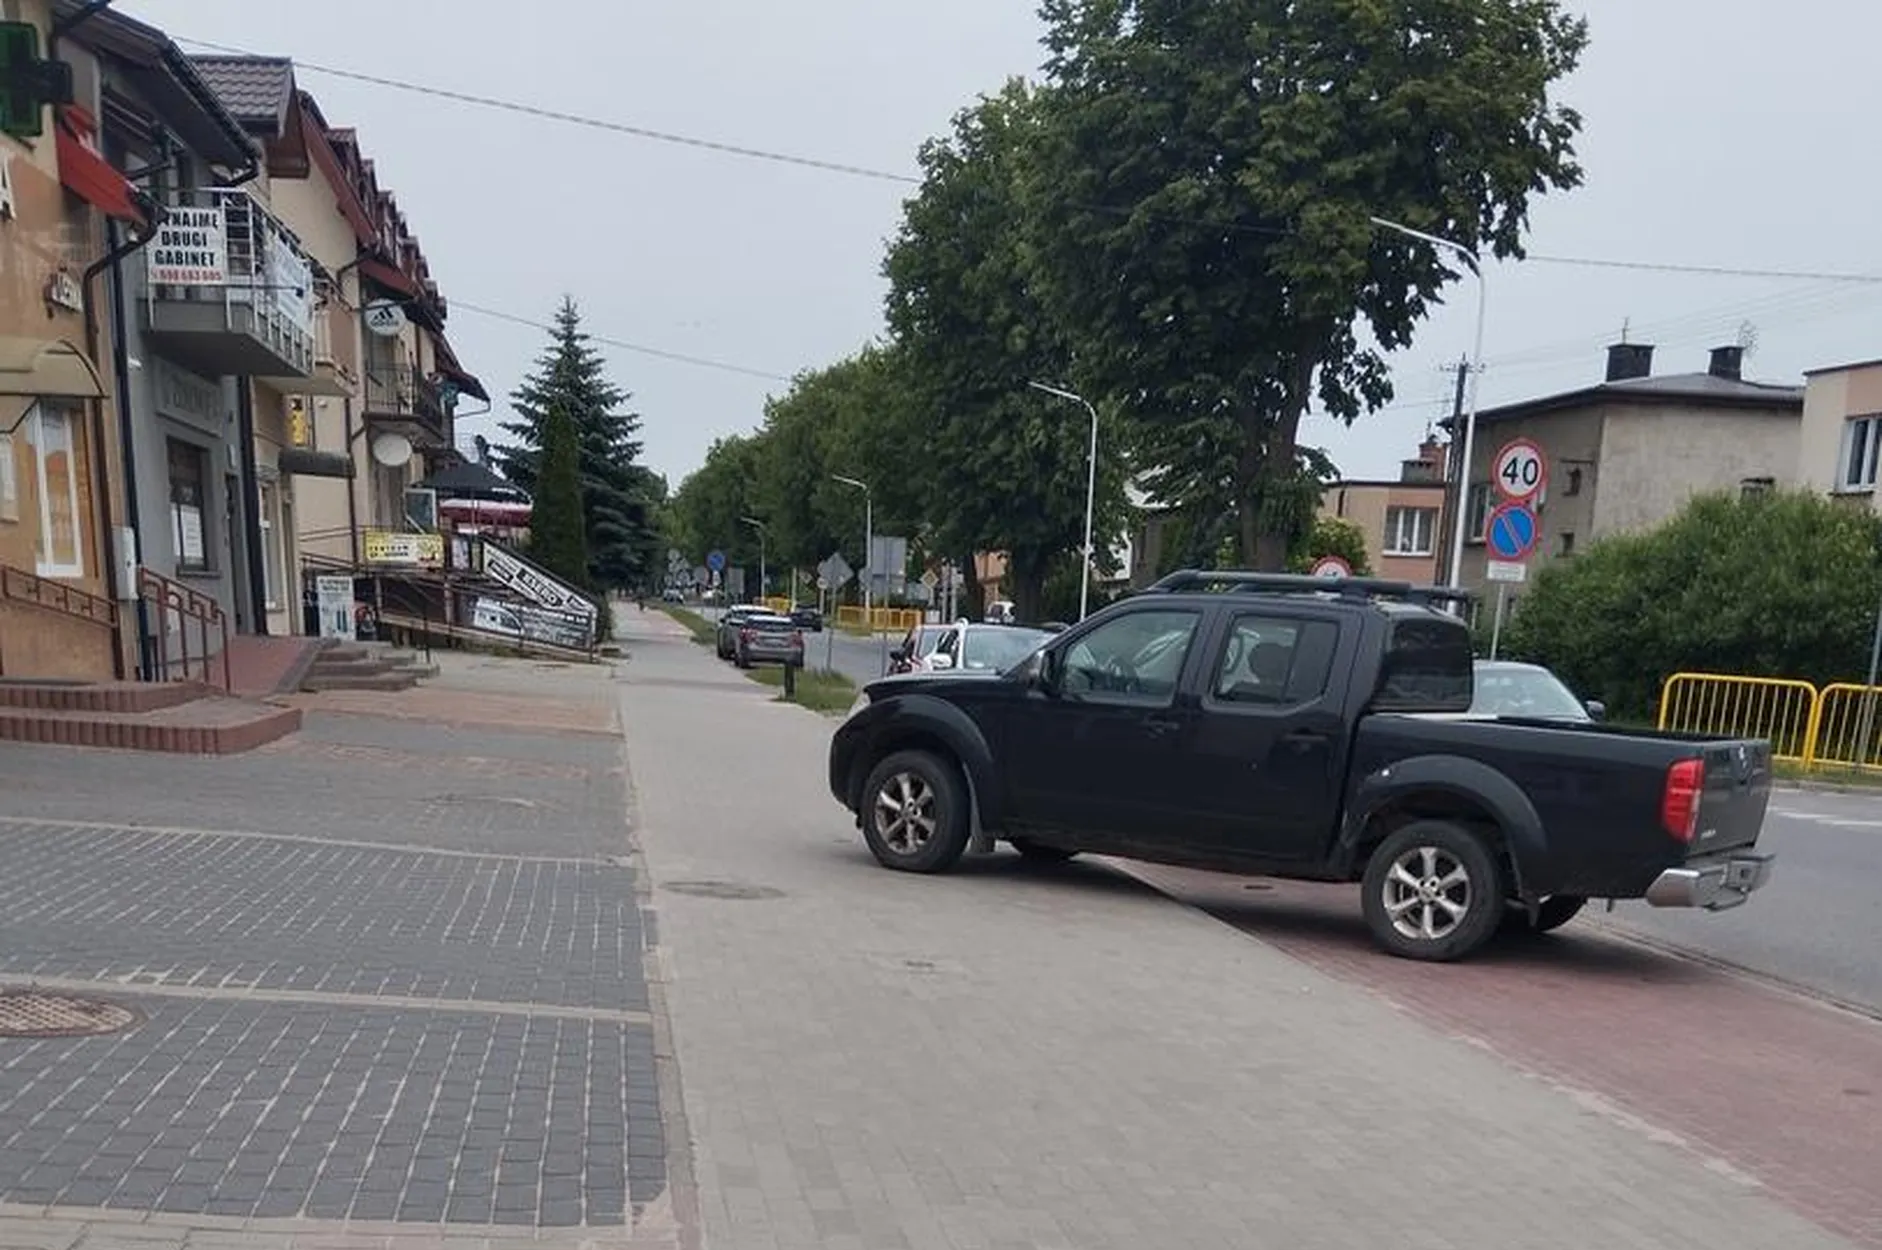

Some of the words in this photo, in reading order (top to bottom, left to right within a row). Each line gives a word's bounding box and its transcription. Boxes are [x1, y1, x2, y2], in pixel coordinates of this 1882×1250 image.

[161, 231, 207, 247] DRUGI
[155, 250, 215, 266] GABINET
[1502, 457, 1538, 486] 40
